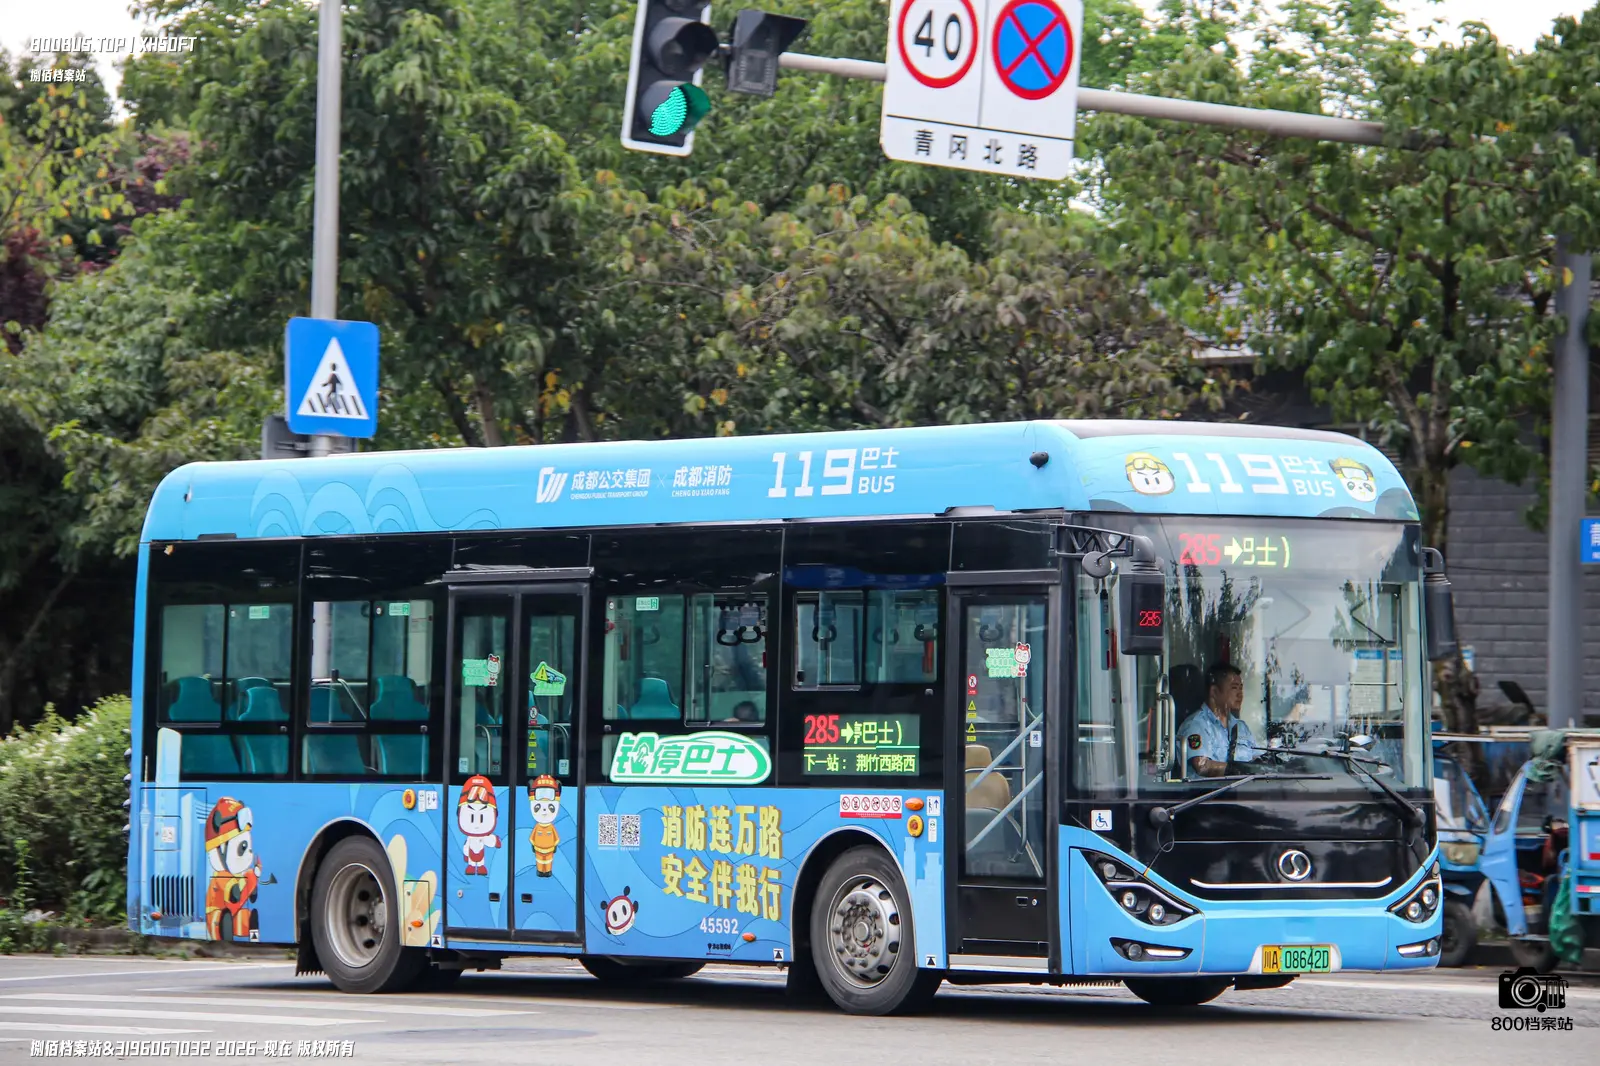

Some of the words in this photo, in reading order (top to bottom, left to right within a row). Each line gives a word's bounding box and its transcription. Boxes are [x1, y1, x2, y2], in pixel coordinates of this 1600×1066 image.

[914, 9, 962, 61] 40
[915, 129, 1038, 170] 青冈北路
[571, 468, 652, 491] 成都公交集团
[673, 465, 732, 487] 成都消防
[766, 448, 857, 497] 119
[860, 447, 900, 469] 巴士
[858, 475, 895, 494] BUS
[1172, 452, 1289, 494] 119
[1279, 455, 1328, 475] 巴士
[1292, 479, 1336, 497] BUS
[1178, 533, 1222, 566] 285
[1140, 611, 1161, 626] 285
[804, 715, 839, 744] 285
[661, 853, 783, 921] 安全伴我行
[700, 917, 739, 934] 45592
